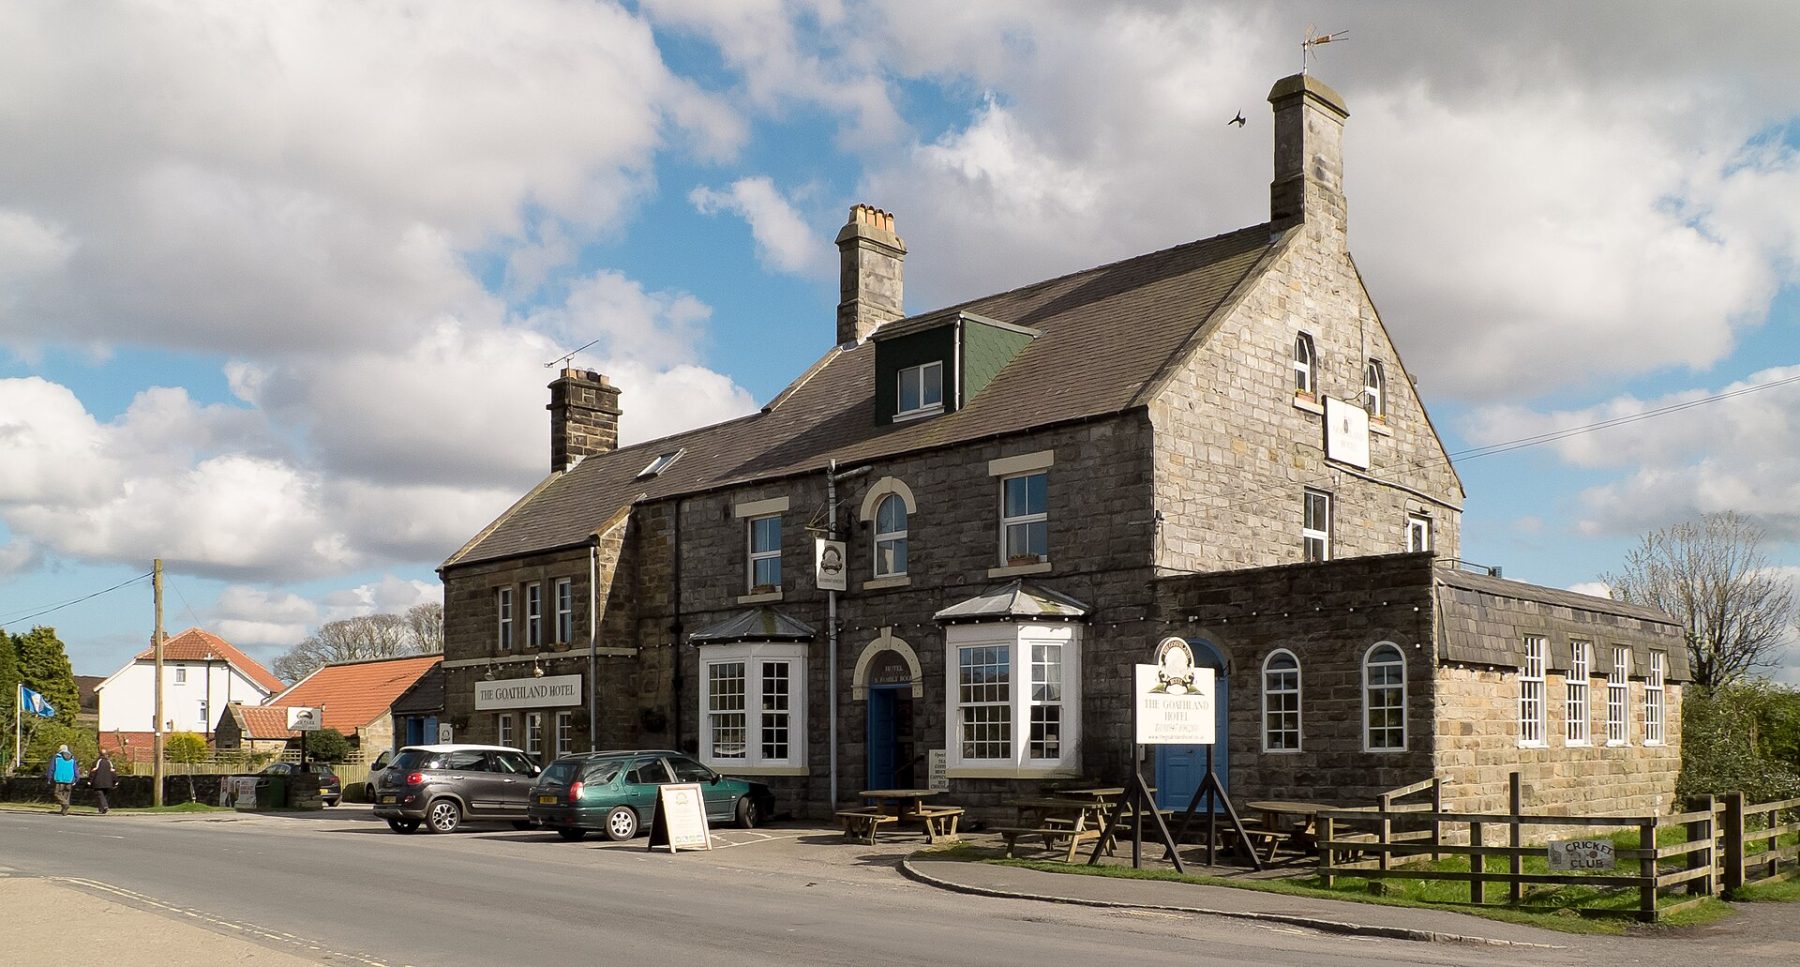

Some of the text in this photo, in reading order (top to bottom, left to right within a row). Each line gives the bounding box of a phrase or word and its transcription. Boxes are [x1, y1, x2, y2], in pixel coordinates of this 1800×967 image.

[481, 684, 575, 701] THE GOATHLAND HOTEL
[1144, 698, 1210, 711] THE GOATHLAND
[1164, 711, 1189, 721] HOTEL
[1565, 841, 1613, 855] CRICKET
[1570, 859, 1604, 868] CLUB
